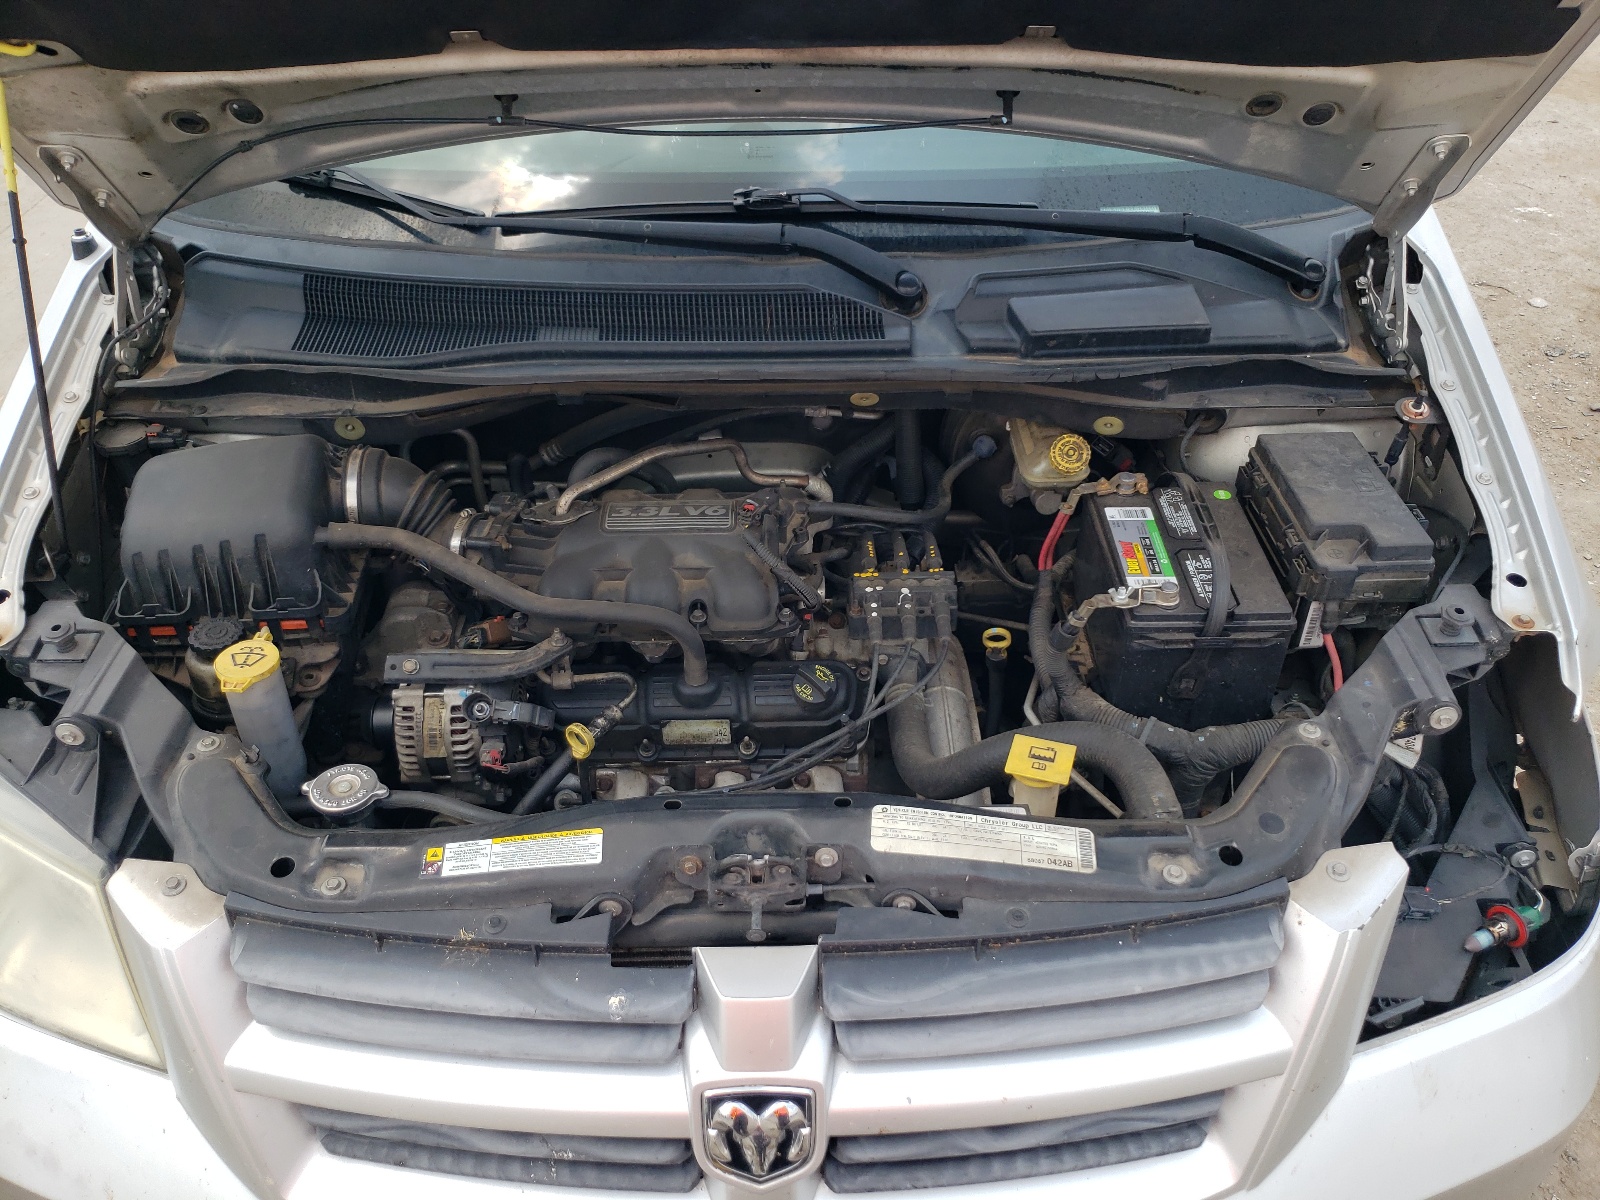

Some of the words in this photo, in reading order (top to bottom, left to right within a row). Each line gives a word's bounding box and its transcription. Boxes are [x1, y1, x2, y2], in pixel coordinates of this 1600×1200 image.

[611, 506, 680, 517] 3.3L
[685, 505, 727, 516] V6
[1119, 540, 1142, 575] EverStart
[980, 817, 1008, 826] Chrysler
[1011, 820, 1029, 829] Group
[1047, 858, 1073, 868] 042AB
